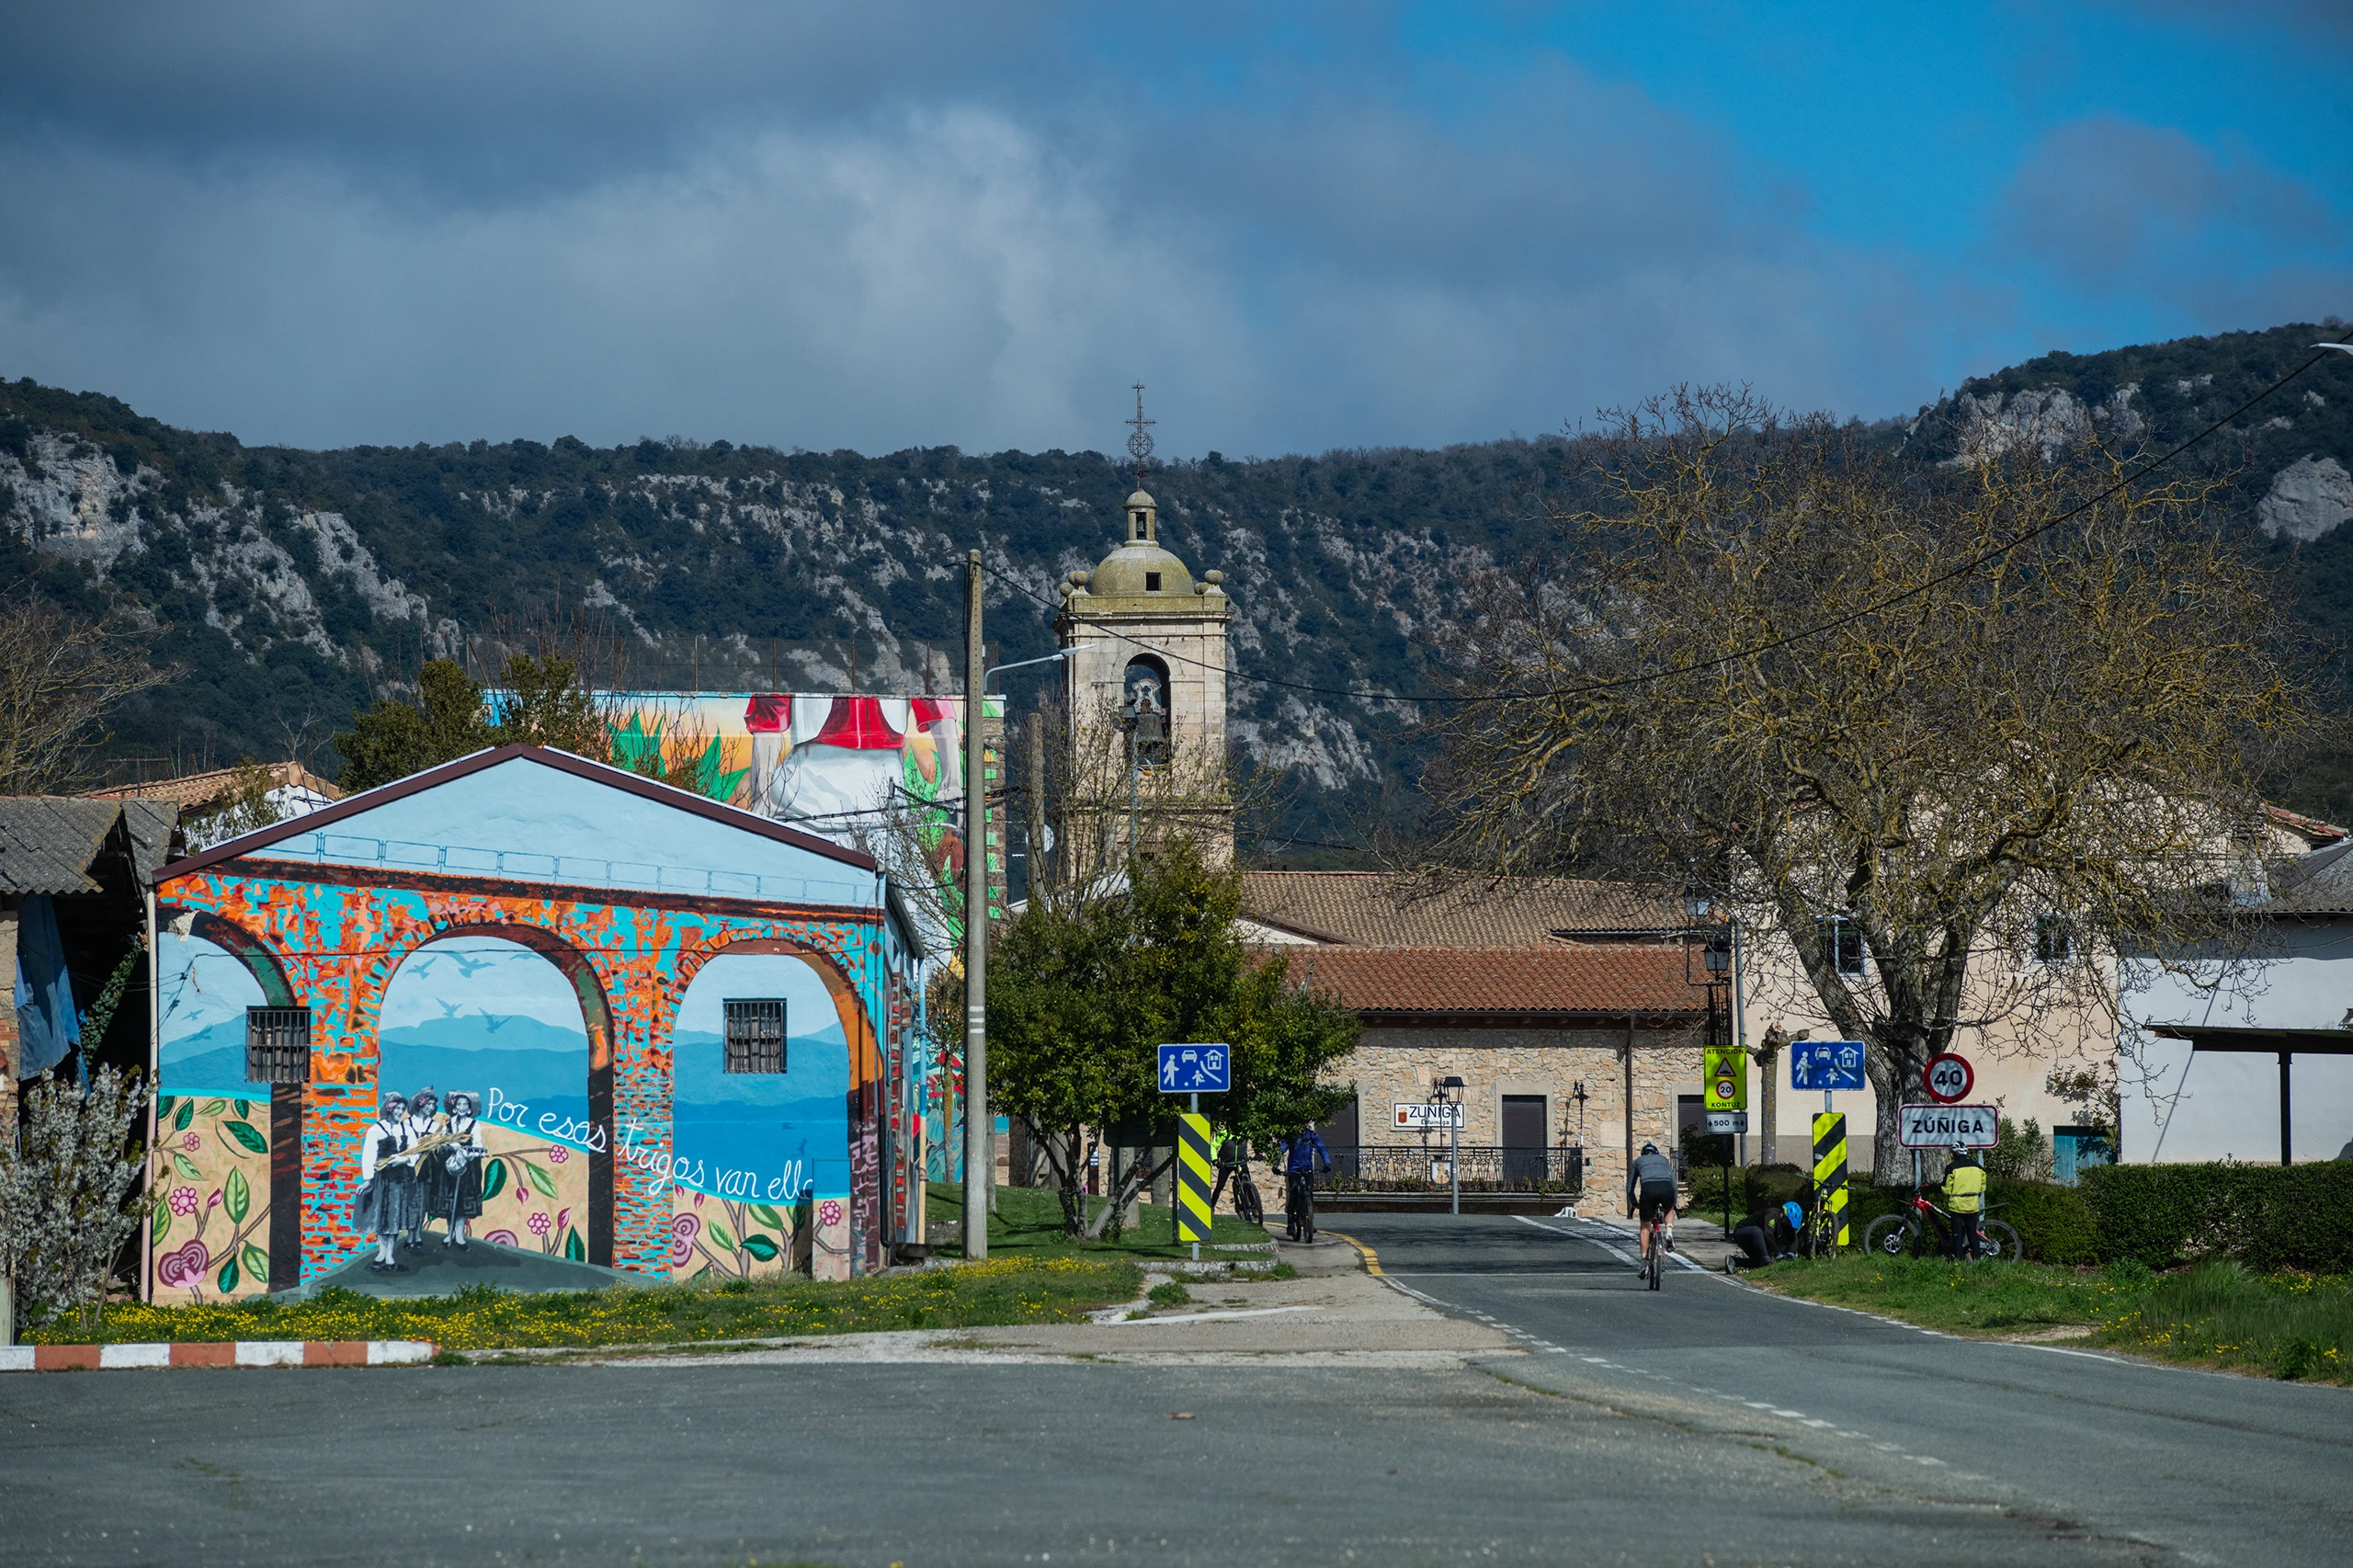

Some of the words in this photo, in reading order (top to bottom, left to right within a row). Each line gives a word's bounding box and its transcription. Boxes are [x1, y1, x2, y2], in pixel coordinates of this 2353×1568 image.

[1934, 1070, 1963, 1086] 40
[1912, 1117, 1984, 1133] ZÚÑIGA
[487, 1087, 529, 1128] Por
[539, 1112, 607, 1153] esos
[618, 1117, 704, 1196] trigos
[715, 1166, 760, 1199] van
